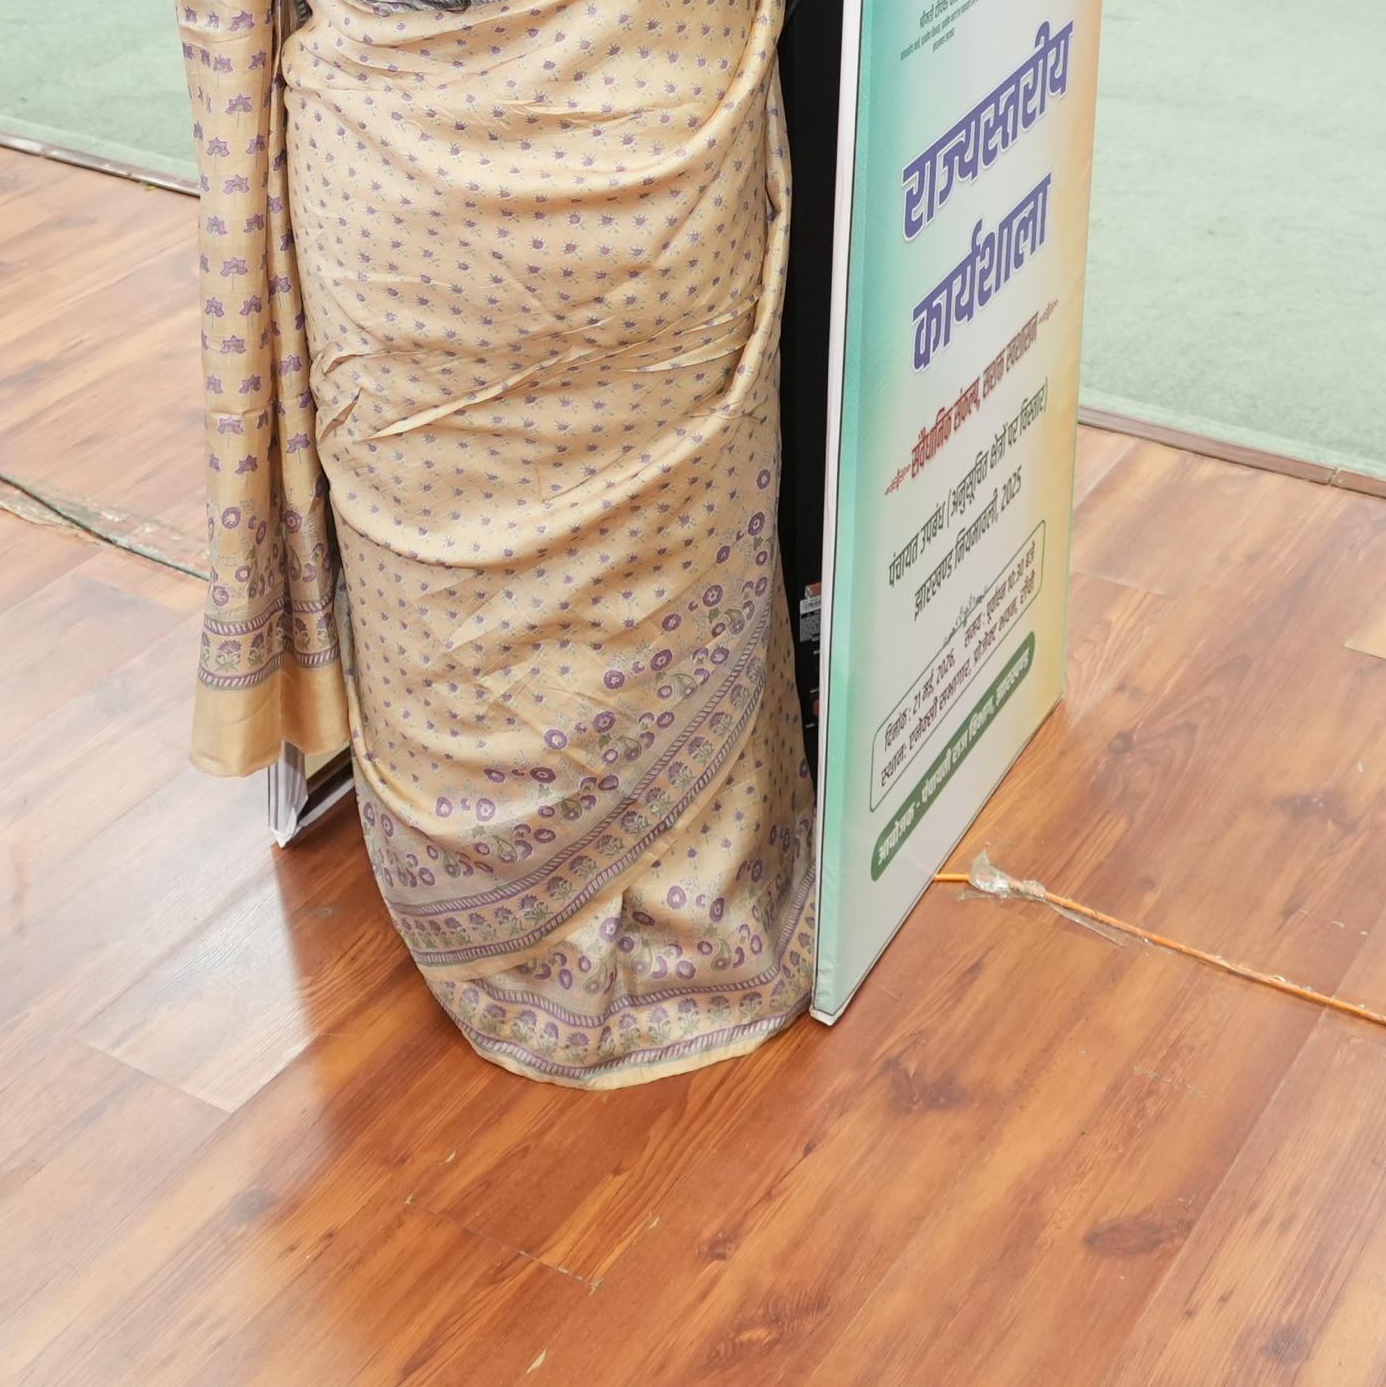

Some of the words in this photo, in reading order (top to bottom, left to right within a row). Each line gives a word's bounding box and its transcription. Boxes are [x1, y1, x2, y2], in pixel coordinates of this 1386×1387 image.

[903, 21, 1074, 240] राज्यस्तरीय
[912, 172, 1052, 371] कार्यशाला
[889, 531, 919, 588] पंचायत
[920, 501, 946, 554] उपबंध
[946, 450, 989, 528] (अनुसूचित
[1007, 416, 1020, 446] पर
[911, 407, 954, 478] संवैधानिक
[915, 549, 954, 622] झारखण्ड
[954, 487, 999, 569] नियमावली,
[1001, 465, 1022, 512] 2025
